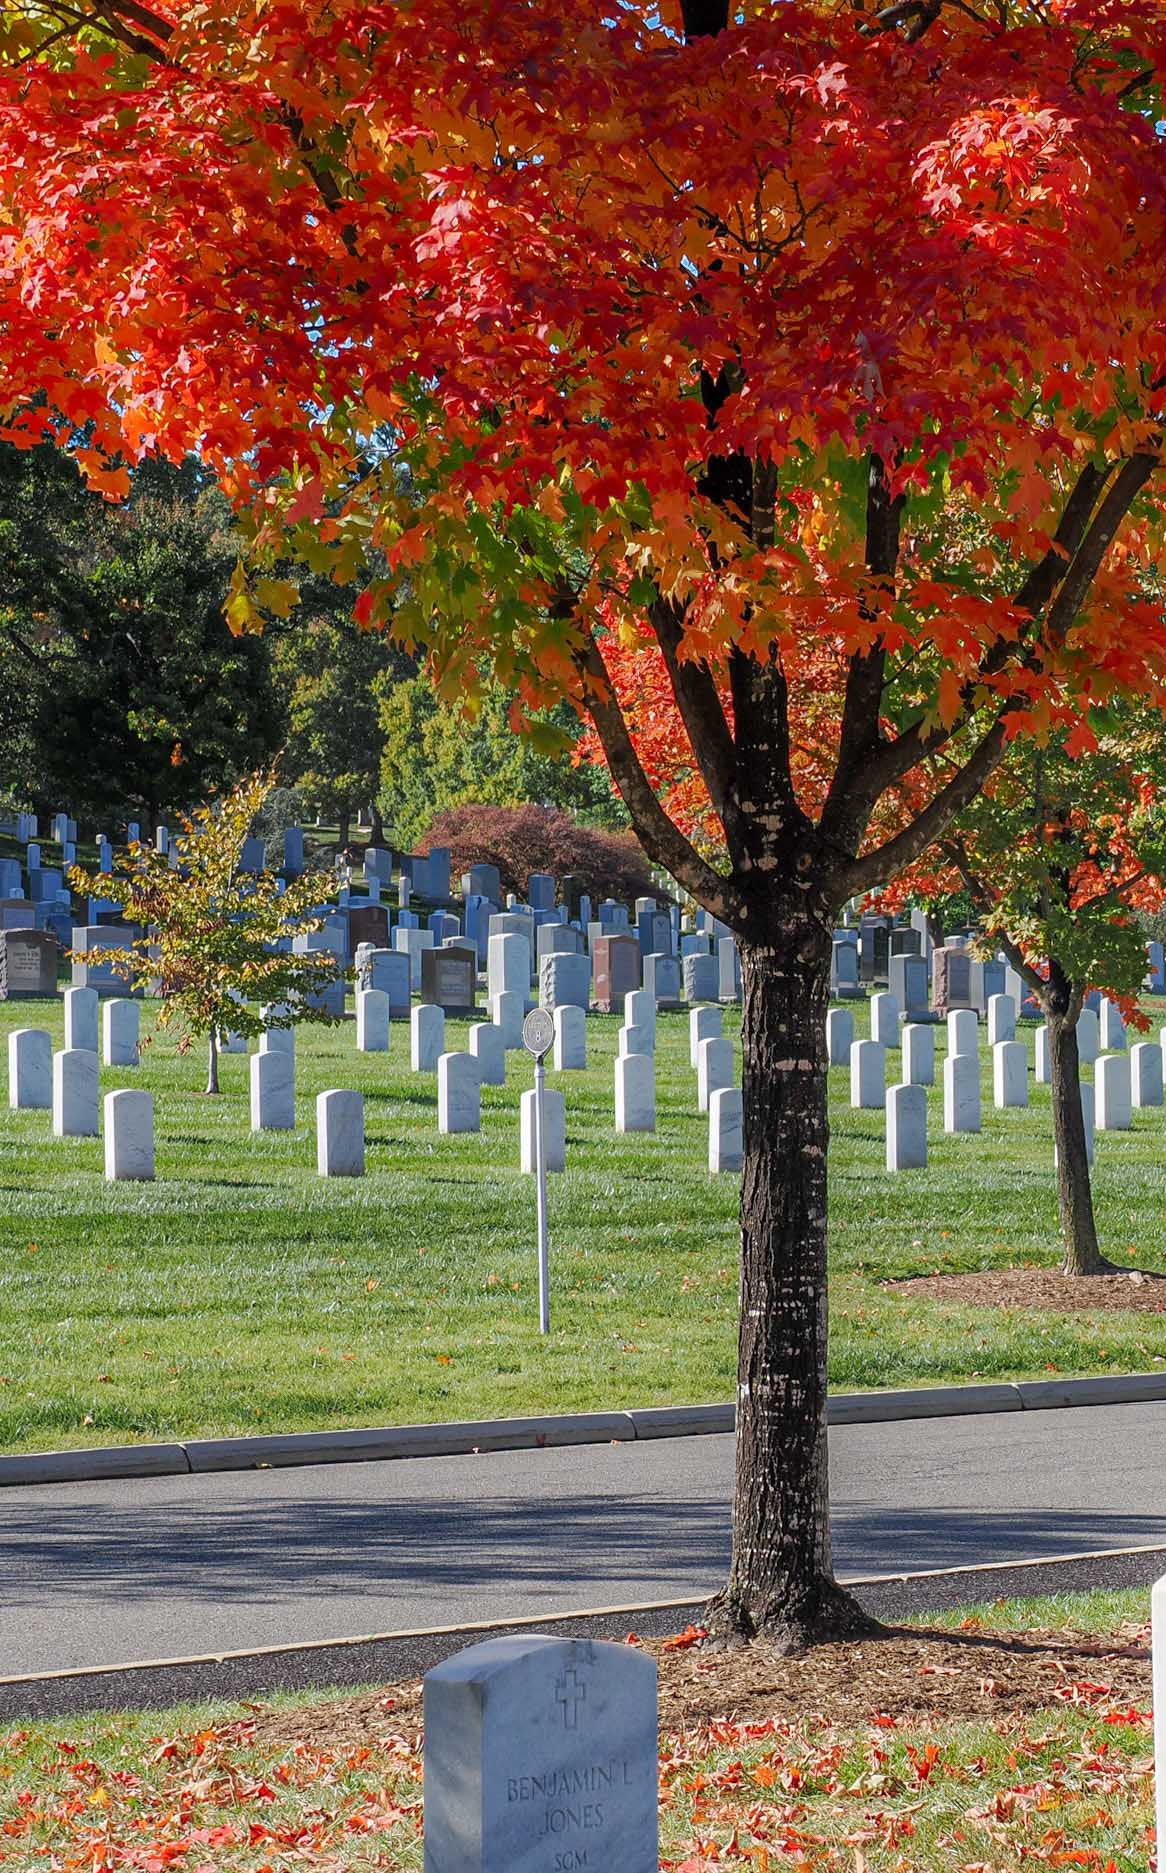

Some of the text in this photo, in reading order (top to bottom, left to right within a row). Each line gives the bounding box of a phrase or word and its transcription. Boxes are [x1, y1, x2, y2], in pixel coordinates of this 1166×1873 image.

[536, 1031, 541, 1042] 8
[507, 1758, 633, 1801] BENJAMIN L
[537, 1803, 604, 1836] JONES
[554, 1849, 588, 1872] SGM
